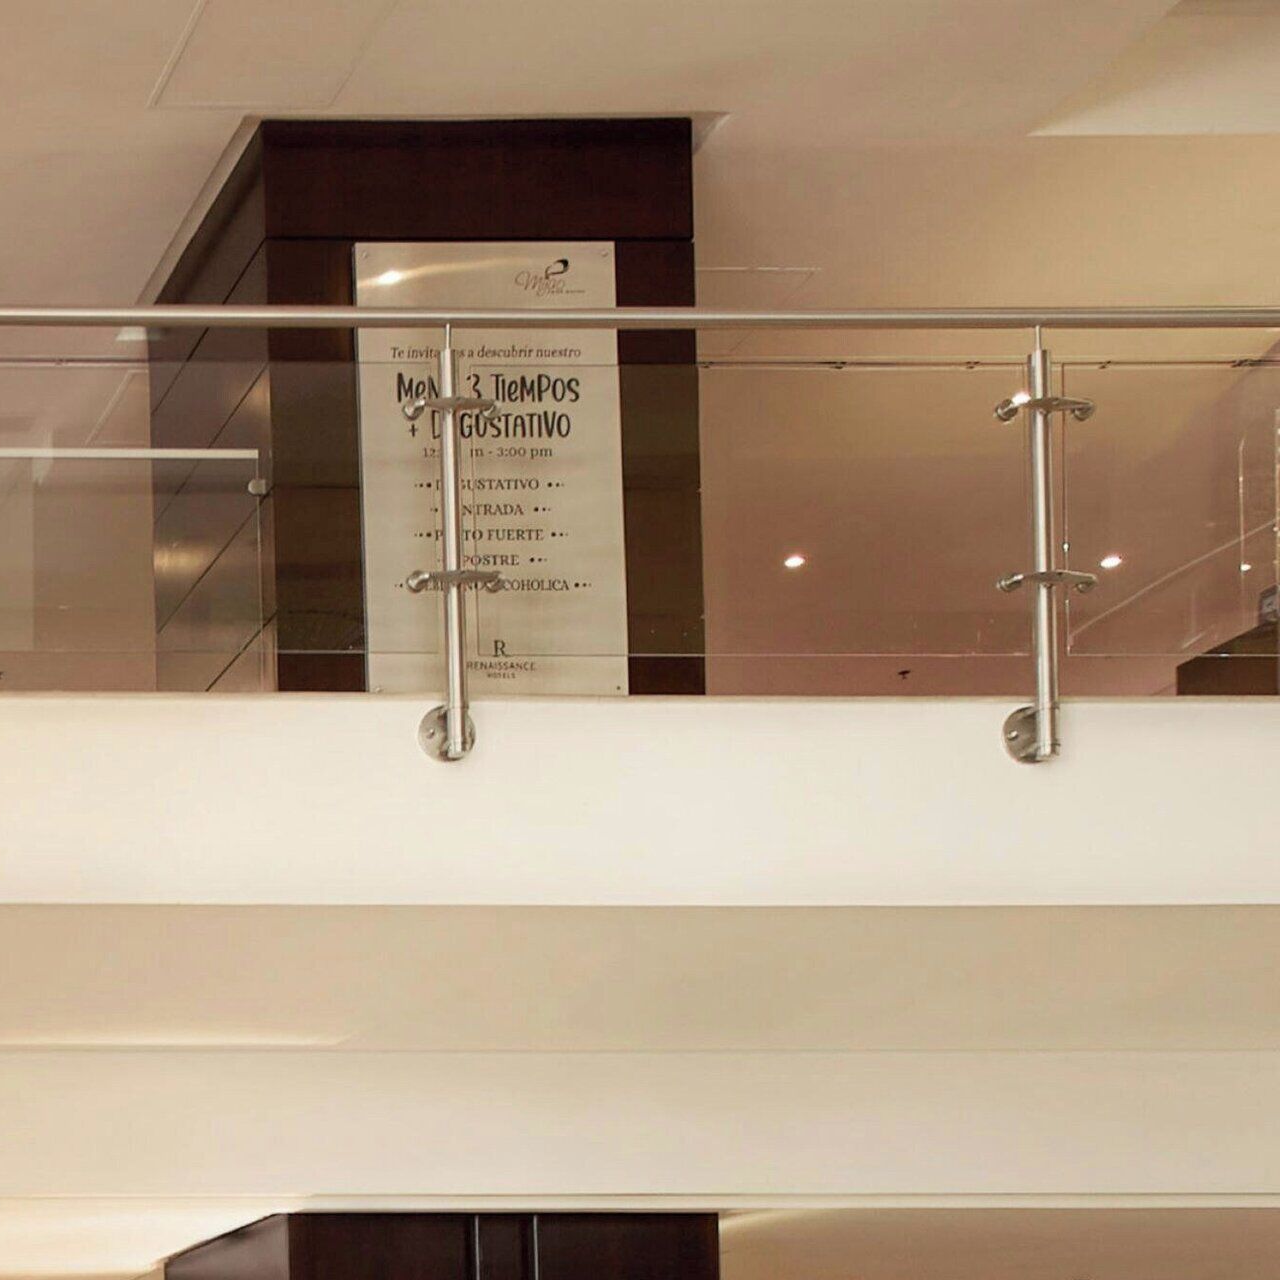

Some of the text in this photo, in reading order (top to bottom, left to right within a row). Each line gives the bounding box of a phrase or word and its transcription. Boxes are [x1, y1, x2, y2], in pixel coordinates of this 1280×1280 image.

[391, 347, 405, 359] Te
[407, 346, 465, 359] invits
[477, 346, 533, 359] descubrir
[536, 349, 582, 359] nuestro
[431, 410, 571, 439] DGUSTATIVO
[497, 448, 526, 457] 3:00
[530, 448, 553, 460] pm
[436, 479, 540, 491] GUSTATIVO
[462, 504, 524, 516] NTRADA
[435, 529, 544, 541] PTO FUERTE
[493, 640, 511, 657] R
[466, 661, 537, 671] RENAISSANCE
